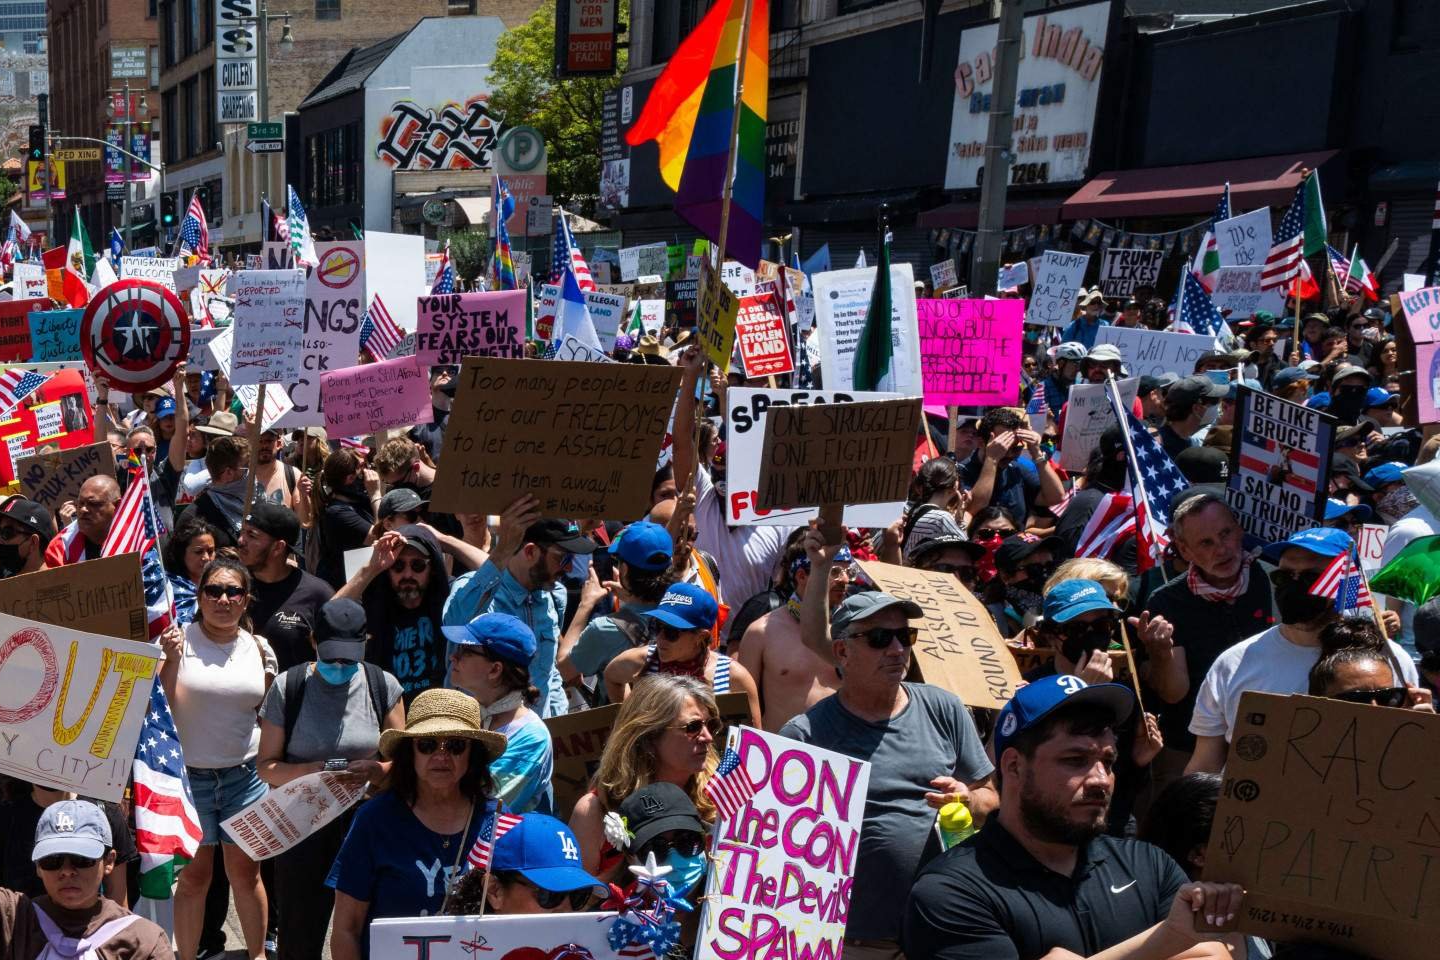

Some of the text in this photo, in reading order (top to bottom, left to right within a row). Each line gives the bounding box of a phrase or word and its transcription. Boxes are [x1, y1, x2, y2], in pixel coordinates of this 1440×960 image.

[221, 62, 253, 87] CUTLERY
[221, 95, 255, 120] SHARPENING
[58, 150, 98, 159] PED XING
[1230, 225, 1256, 248] We
[122, 257, 177, 270] IMMIGRANTS
[1046, 253, 1085, 268] TRUMP
[1110, 250, 1162, 266] TRUMP
[126, 267, 174, 279] WELCOME
[1107, 265, 1159, 282] LIKES
[237, 286, 281, 296] DEPORTED
[588, 294, 621, 308] ILLEGAL
[419, 295, 463, 314] YOUR
[1403, 291, 1431, 316] KEEP
[0, 316, 25, 327] FIGHT
[36, 317, 78, 335] Liberty
[432, 309, 509, 332] SYSTEM
[418, 326, 519, 351] FEARS OUR
[742, 330, 784, 344] STOLEN
[39, 341, 81, 360] Justice
[236, 348, 284, 359] CONDEMNED
[744, 340, 786, 358] LAND
[1136, 335, 1168, 363] Will
[368, 384, 405, 399] Deserve
[469, 365, 673, 401] Too many people died
[475, 402, 668, 437] for our FREEDOMS
[772, 404, 916, 438] ONE STRUGGLE!
[1253, 394, 1316, 433] BE LIKE
[1253, 415, 1312, 453] BRUCE.
[453, 431, 647, 462] to let one ASSHOLE
[771, 436, 890, 467] ONE FIGHT!
[460, 465, 623, 495] take them away!!!
[763, 463, 908, 505] ALL WORKERS UNITE
[1227, 487, 1246, 511] TO
[1244, 475, 1302, 512] SAY NO
[661, 588, 694, 605] Dodgers
[739, 728, 864, 822] DON
[556, 831, 579, 861] LA
